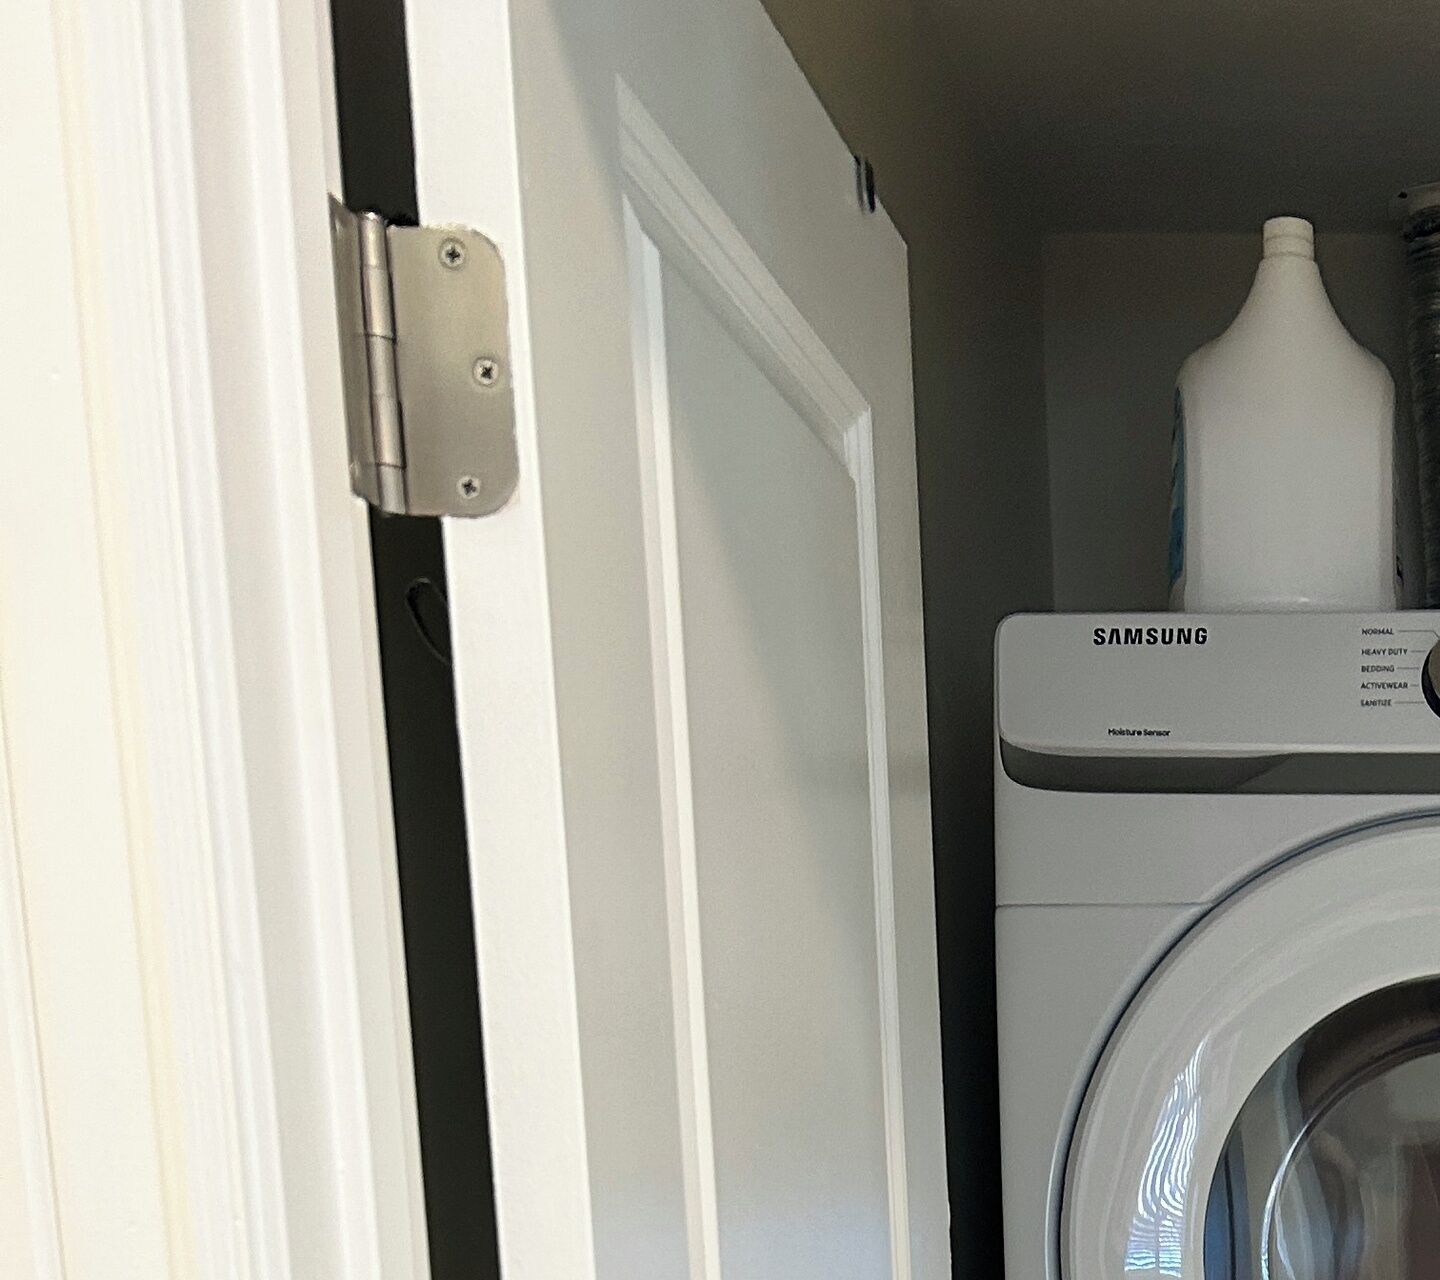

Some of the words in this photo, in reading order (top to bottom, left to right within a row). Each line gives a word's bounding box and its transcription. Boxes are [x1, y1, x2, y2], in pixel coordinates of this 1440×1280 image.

[1361, 628, 1395, 636] NORMAL
[1093, 627, 1208, 646] SAMSUNG
[1361, 648, 1387, 656] HEAVY
[1388, 648, 1408, 656] DUTY
[1361, 665, 1395, 673] BEDDING
[1360, 681, 1409, 690] ACTIVEWEAR
[1361, 699, 1392, 707] SANITIZE
[1108, 728, 1142, 737] Moisture
[1143, 728, 1171, 737] Sensor
